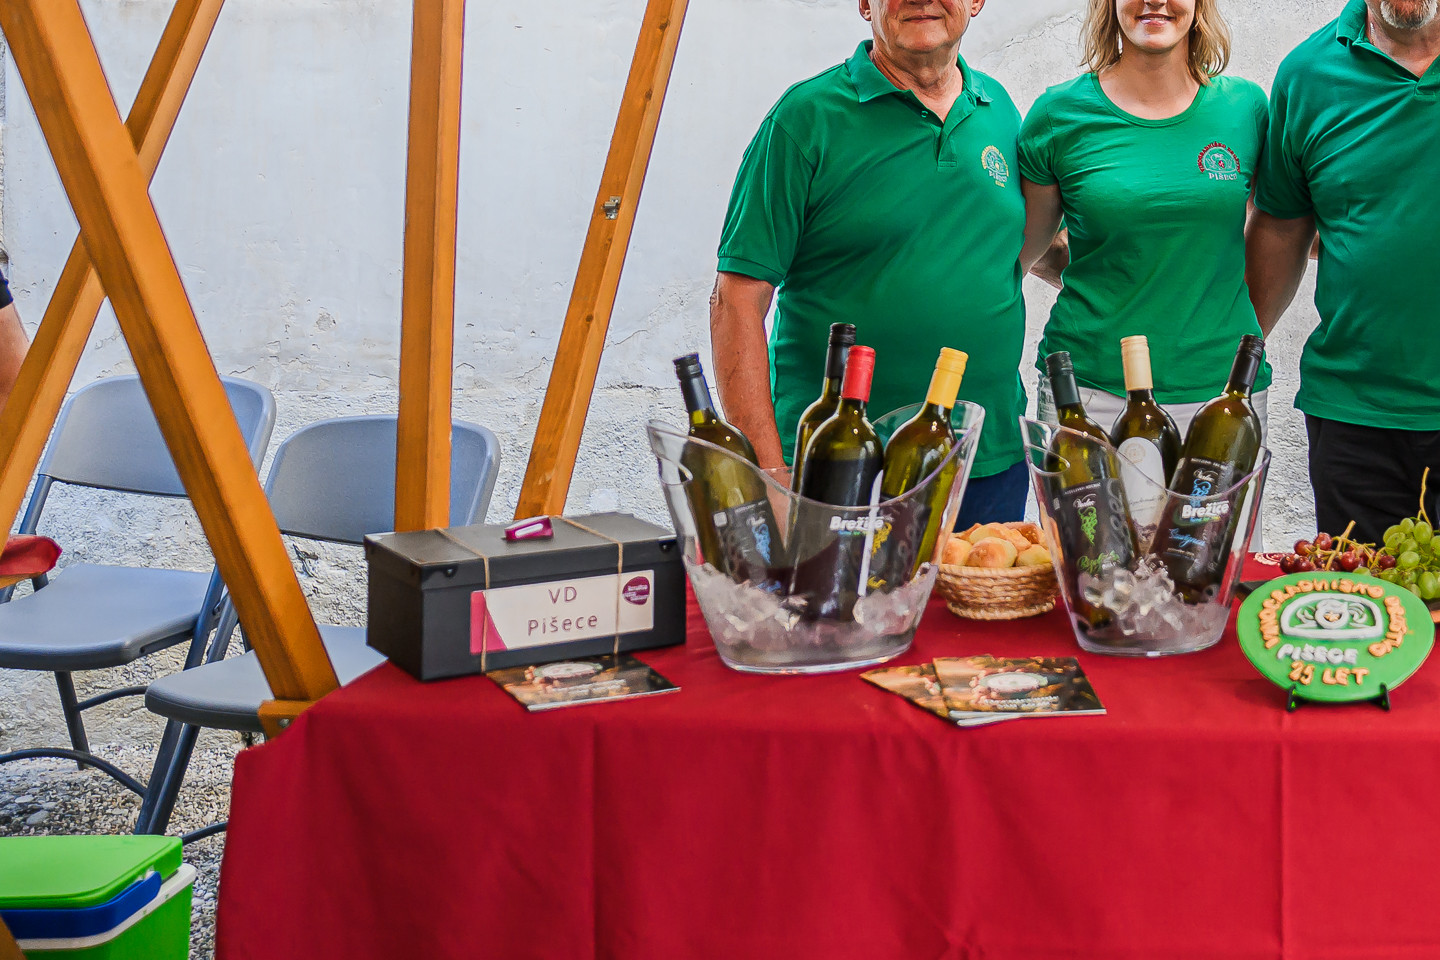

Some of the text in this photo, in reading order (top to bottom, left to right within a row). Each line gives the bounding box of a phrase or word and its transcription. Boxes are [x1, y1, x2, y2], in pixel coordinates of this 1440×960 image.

[830, 515, 884, 532] Brežie
[548, 586, 577, 604] VD
[527, 615, 598, 636] Pišece
[1288, 660, 1370, 685] 25 LET
